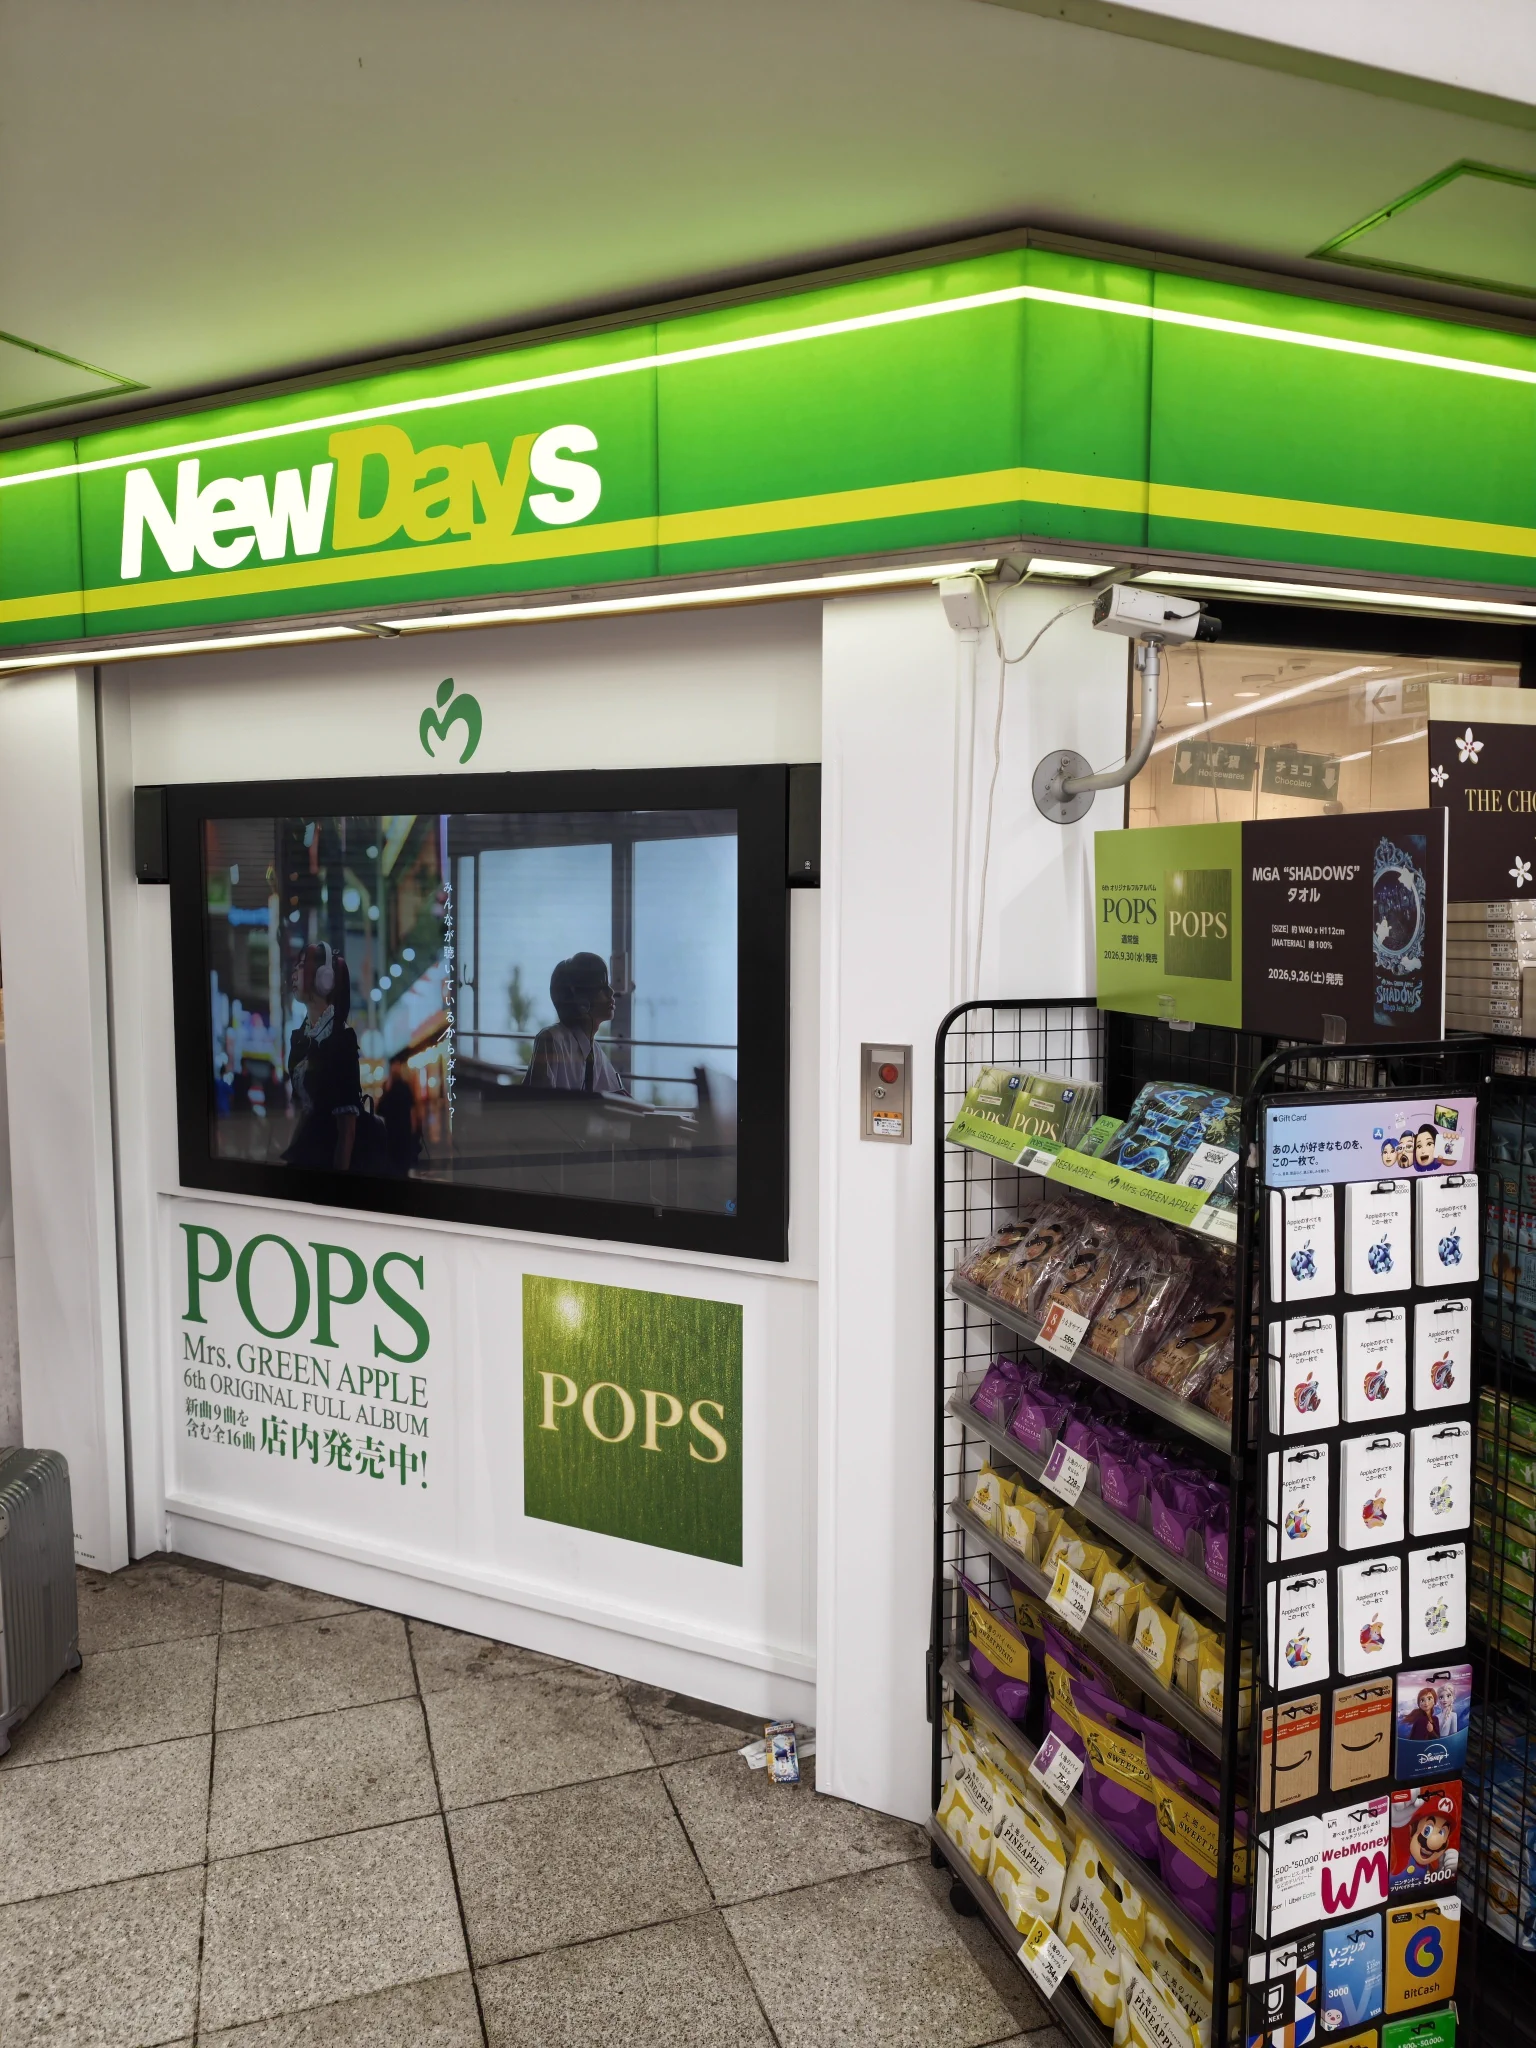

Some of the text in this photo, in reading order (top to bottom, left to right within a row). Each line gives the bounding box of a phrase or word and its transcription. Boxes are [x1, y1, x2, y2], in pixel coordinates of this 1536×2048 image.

[121, 424, 601, 579] NewDays
[1199, 769, 1244, 780] Housewares
[1276, 761, 1312, 776] チョコ
[1275, 776, 1311, 788] Chocolate
[1465, 789, 1502, 811] THE
[1252, 867, 1280, 881] MGA
[1110, 884, 1157, 892] オリジナルフルアルバム
[1288, 887, 1321, 902] タオル
[1103, 898, 1157, 925] POPS
[1169, 911, 1228, 939] POPS
[1298, 926, 1313, 934] W40
[1319, 927, 1345, 936] H112cm
[1121, 935, 1139, 944] 通常盤
[1316, 941, 1332, 949] 100%
[1278, 1114, 1291, 1122] Gift
[1013, 1112, 1060, 1142] POPS
[977, 1131, 996, 1143] GREEN
[996, 1137, 1016, 1150] APPLE
[1273, 1140, 1363, 1155] あの人が好きなものを、
[1272, 1156, 1319, 1167] この一枚で。
[1072, 1166, 1097, 1180] APPLE
[1120, 1182, 1199, 1214] Mrs. GREEN APPLE
[1435, 1204, 1467, 1213] Appleのすべてを
[1287, 1217, 1322, 1226] Appleのすべてを
[1365, 1211, 1399, 1220] Appleのすべてを
[179, 1223, 430, 1363] POPS
[1051, 1314, 1058, 1325] 8
[1428, 1328, 1460, 1338] Appleのすべてを
[1360, 1338, 1394, 1348] Appleのすべてを
[1367, 1345, 1388, 1353] この一枚で
[1289, 1348, 1324, 1358] Appleのすべてを
[1296, 1356, 1317, 1364] この一枚で
[183, 1332, 428, 1408] Mrs. GREEN APPLE
[184, 1368, 429, 1437] 6th ORIGINAL FULL ALBUM
[185, 1396, 249, 1428] 新曲9曲を
[538, 1370, 728, 1463] POPS
[185, 1418, 255, 1452] 含む全16曲
[260, 1414, 428, 1489] 店内発売中!
[1427, 1453, 1459, 1463] Appleのすべてを
[1055, 1453, 1060, 1465] 1
[1359, 1465, 1392, 1476] Appleのすべてを
[1283, 1475, 1316, 1487] Appleのすべてを
[1289, 1484, 1310, 1492] この一枚で
[1060, 1574, 1065, 1585] 1
[1422, 1574, 1454, 1584] Appleのすべてを
[1428, 1581, 1448, 1589] この一枚で
[1356, 1590, 1389, 1601] Appleのすべてを
[1362, 1598, 1383, 1606] この一枚で
[1281, 1603, 1316, 1616] Appleのすべてを
[1287, 1611, 1309, 1620] この一枚で
[978, 1629, 997, 1647] SWEET
[995, 1643, 1014, 1664] POTATO
[1045, 1744, 1054, 1757] 3
[1107, 1752, 1152, 1782] SWEET PO
[964, 1772, 993, 1814] PINEAPPLE
[1008, 1822, 1036, 1852] 大地のパイ
[1179, 1821, 1208, 1847] SWEET
[1004, 1828, 1045, 1876] PINEAPPLE
[1322, 1835, 1389, 1862] WebMoney
[1394, 1877, 1419, 1886] ニンテンドー
[1424, 1868, 1452, 1884] 5000
[1390, 1882, 1422, 1892] プリペイドカード
[1083, 1895, 1109, 1928] 大地のパイ
[1272, 1903, 1282, 1911] ber
[1081, 1902, 1117, 1956] PINEAPPLE
[1034, 1931, 1043, 1944] 3
[1329, 1956, 1354, 1969] ギフト
[1163, 1970, 1198, 2007] 大地のパイ
[1328, 1987, 1349, 1998] 3000
[1404, 1982, 1440, 2000] BitCash
[1139, 1987, 1169, 2028] 大地のパイ
